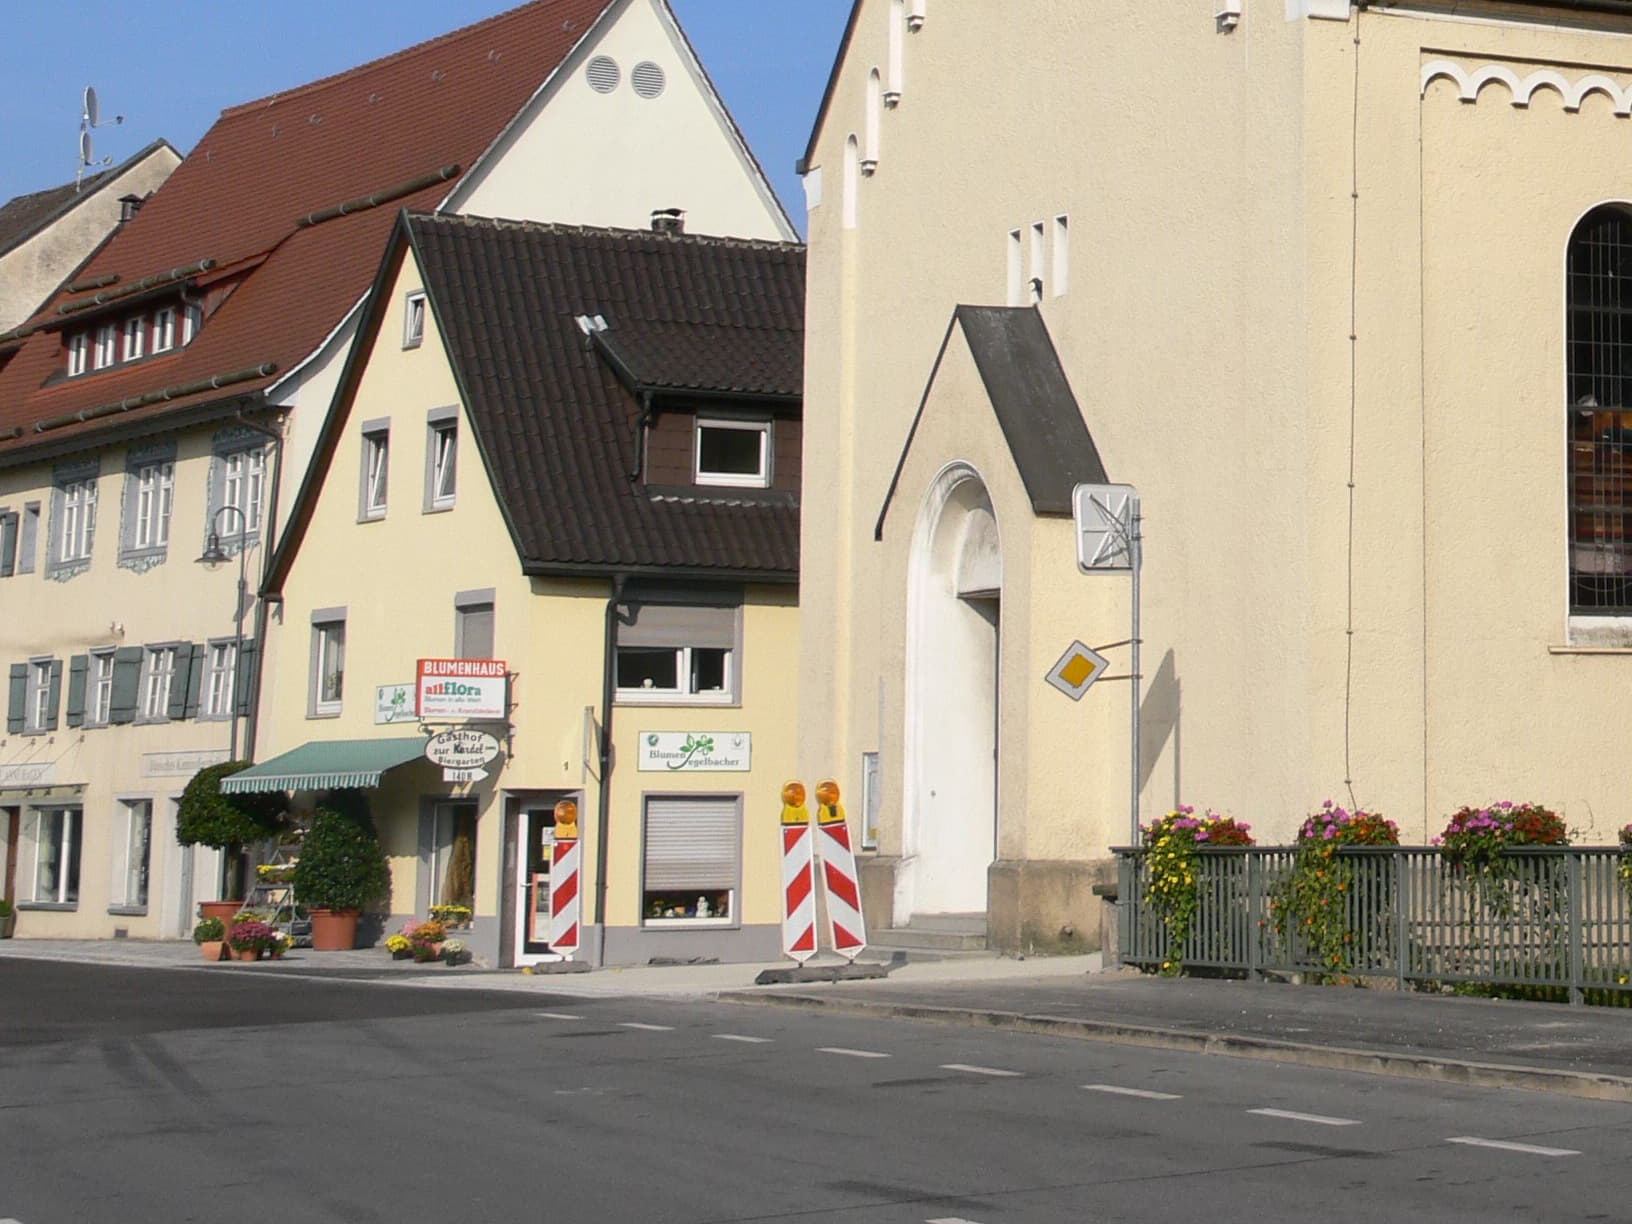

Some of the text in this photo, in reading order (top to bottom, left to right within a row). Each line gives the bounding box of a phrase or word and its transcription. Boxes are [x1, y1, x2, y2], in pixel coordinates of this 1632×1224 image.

[424, 661, 505, 676] BLUMENHAUS
[437, 731, 483, 744] Gasthof
[434, 747, 450, 755] zur
[649, 750, 686, 759] Blumen
[438, 756, 485, 765] Biergarten
